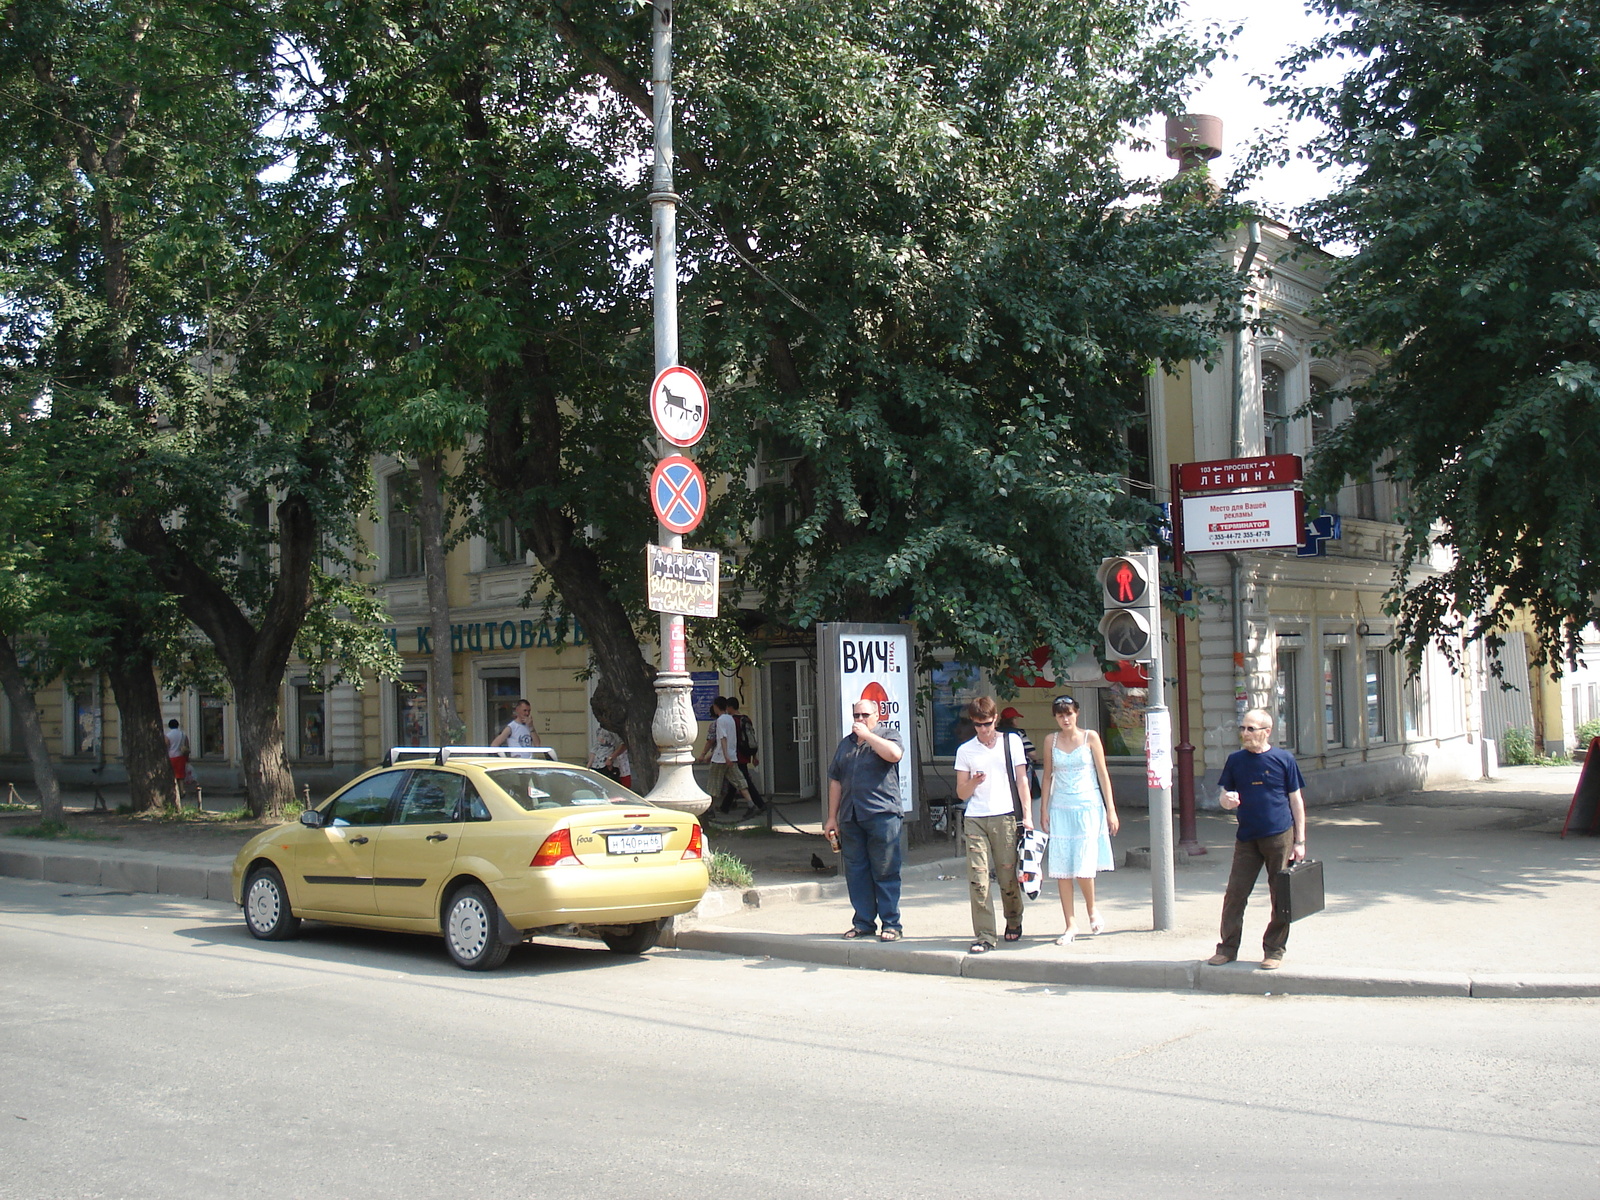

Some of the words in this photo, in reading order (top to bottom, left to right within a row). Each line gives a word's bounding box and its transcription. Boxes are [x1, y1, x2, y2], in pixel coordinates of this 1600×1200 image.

[1200, 466, 1211, 474] 103
[1224, 462, 1258, 472] ПРОСПЕКТ
[1271, 460, 1276, 468] 1
[1200, 470, 1276, 486] ЛЕНИНА
[1231, 504, 1243, 512] для
[1244, 501, 1267, 510] Вашей
[1223, 511, 1253, 520] рекламы
[1219, 521, 1267, 530] ТЕРМИНАТОР
[1214, 532, 1241, 541] 355-44-72
[650, 575, 714, 600] BLOODHOUND
[663, 594, 696, 612] GANG
[880, 701, 900, 715] ЭТО
